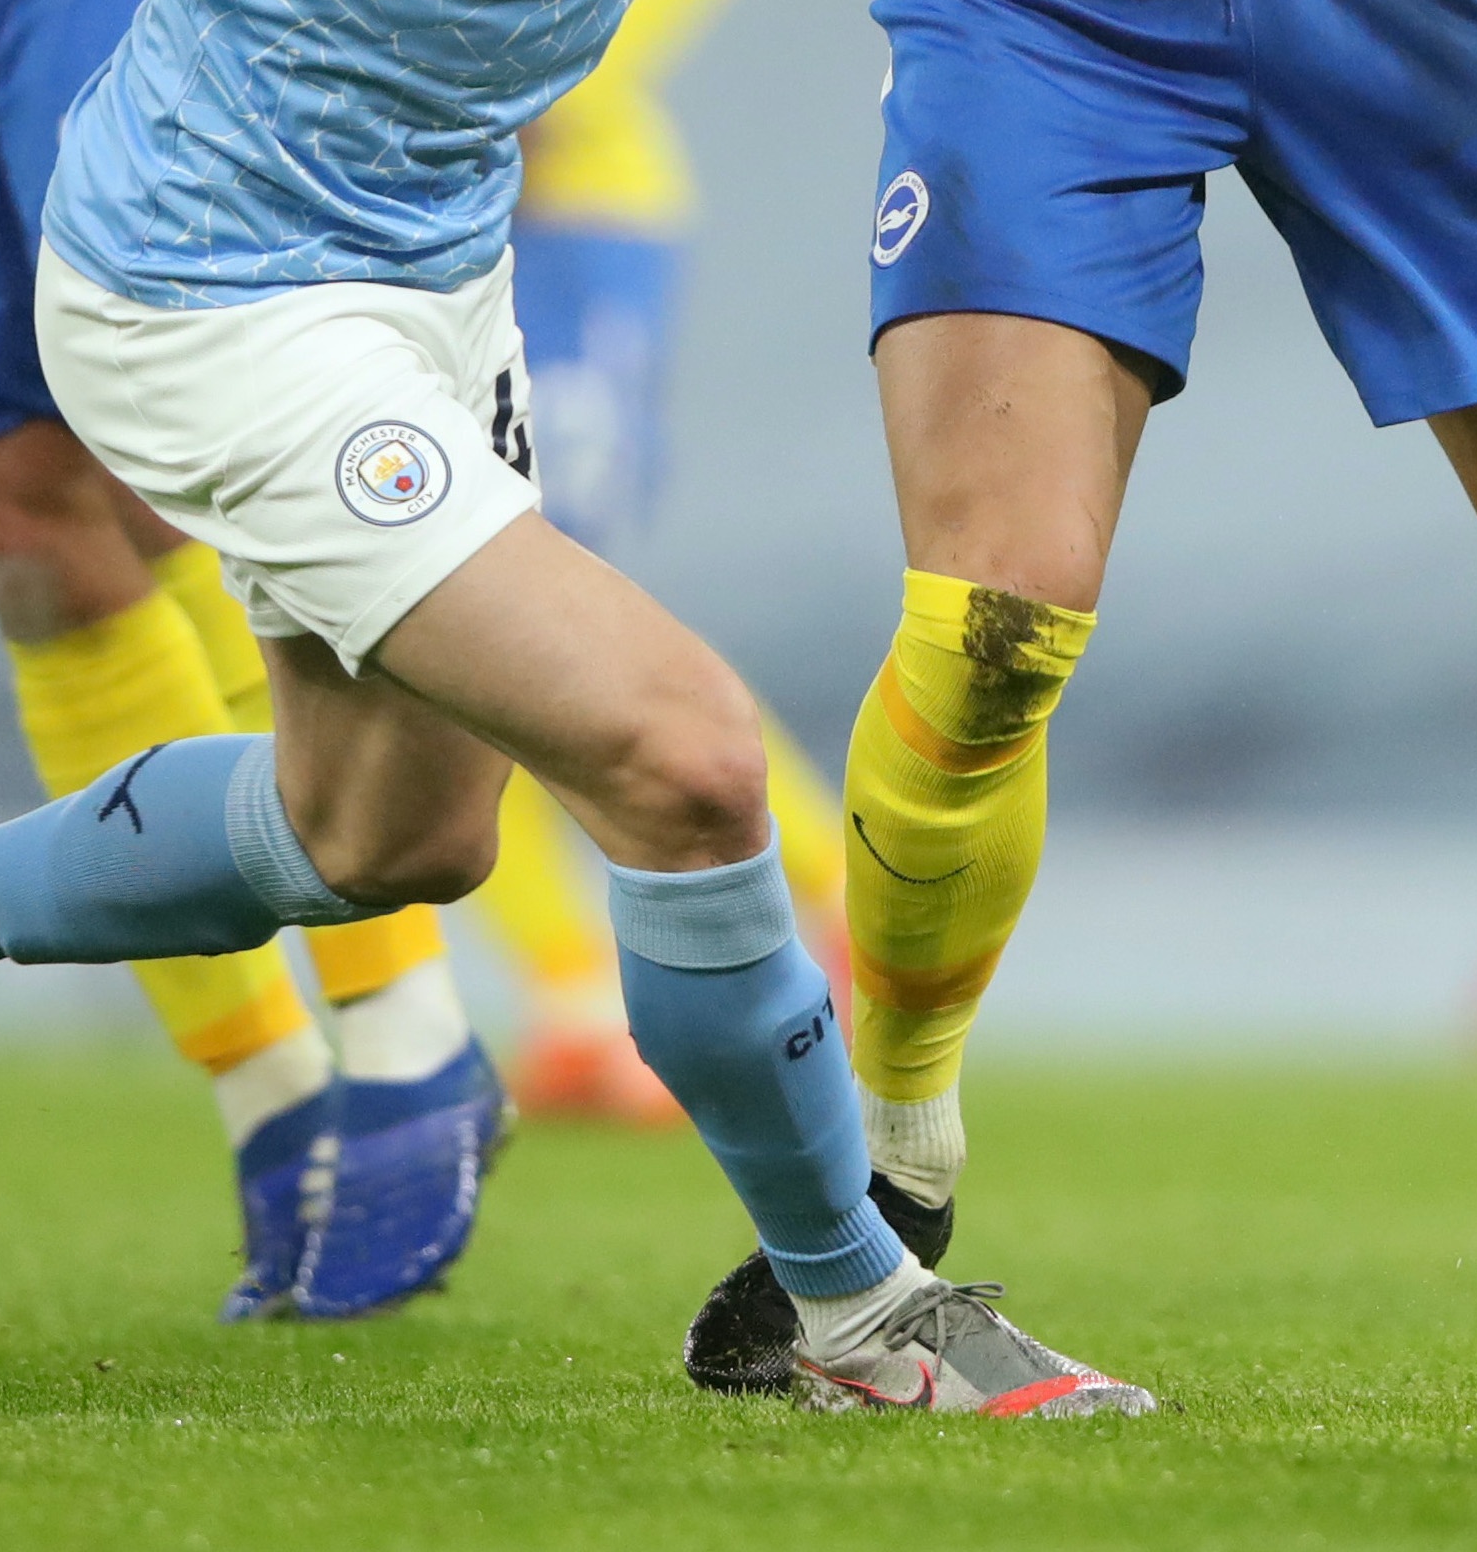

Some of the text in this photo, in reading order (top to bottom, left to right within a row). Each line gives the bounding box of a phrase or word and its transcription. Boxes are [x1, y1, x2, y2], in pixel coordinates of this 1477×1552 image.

[345, 428, 417, 487] MANCHESTER
[407, 490, 435, 514] CITY
[787, 988, 834, 1062] CIT
